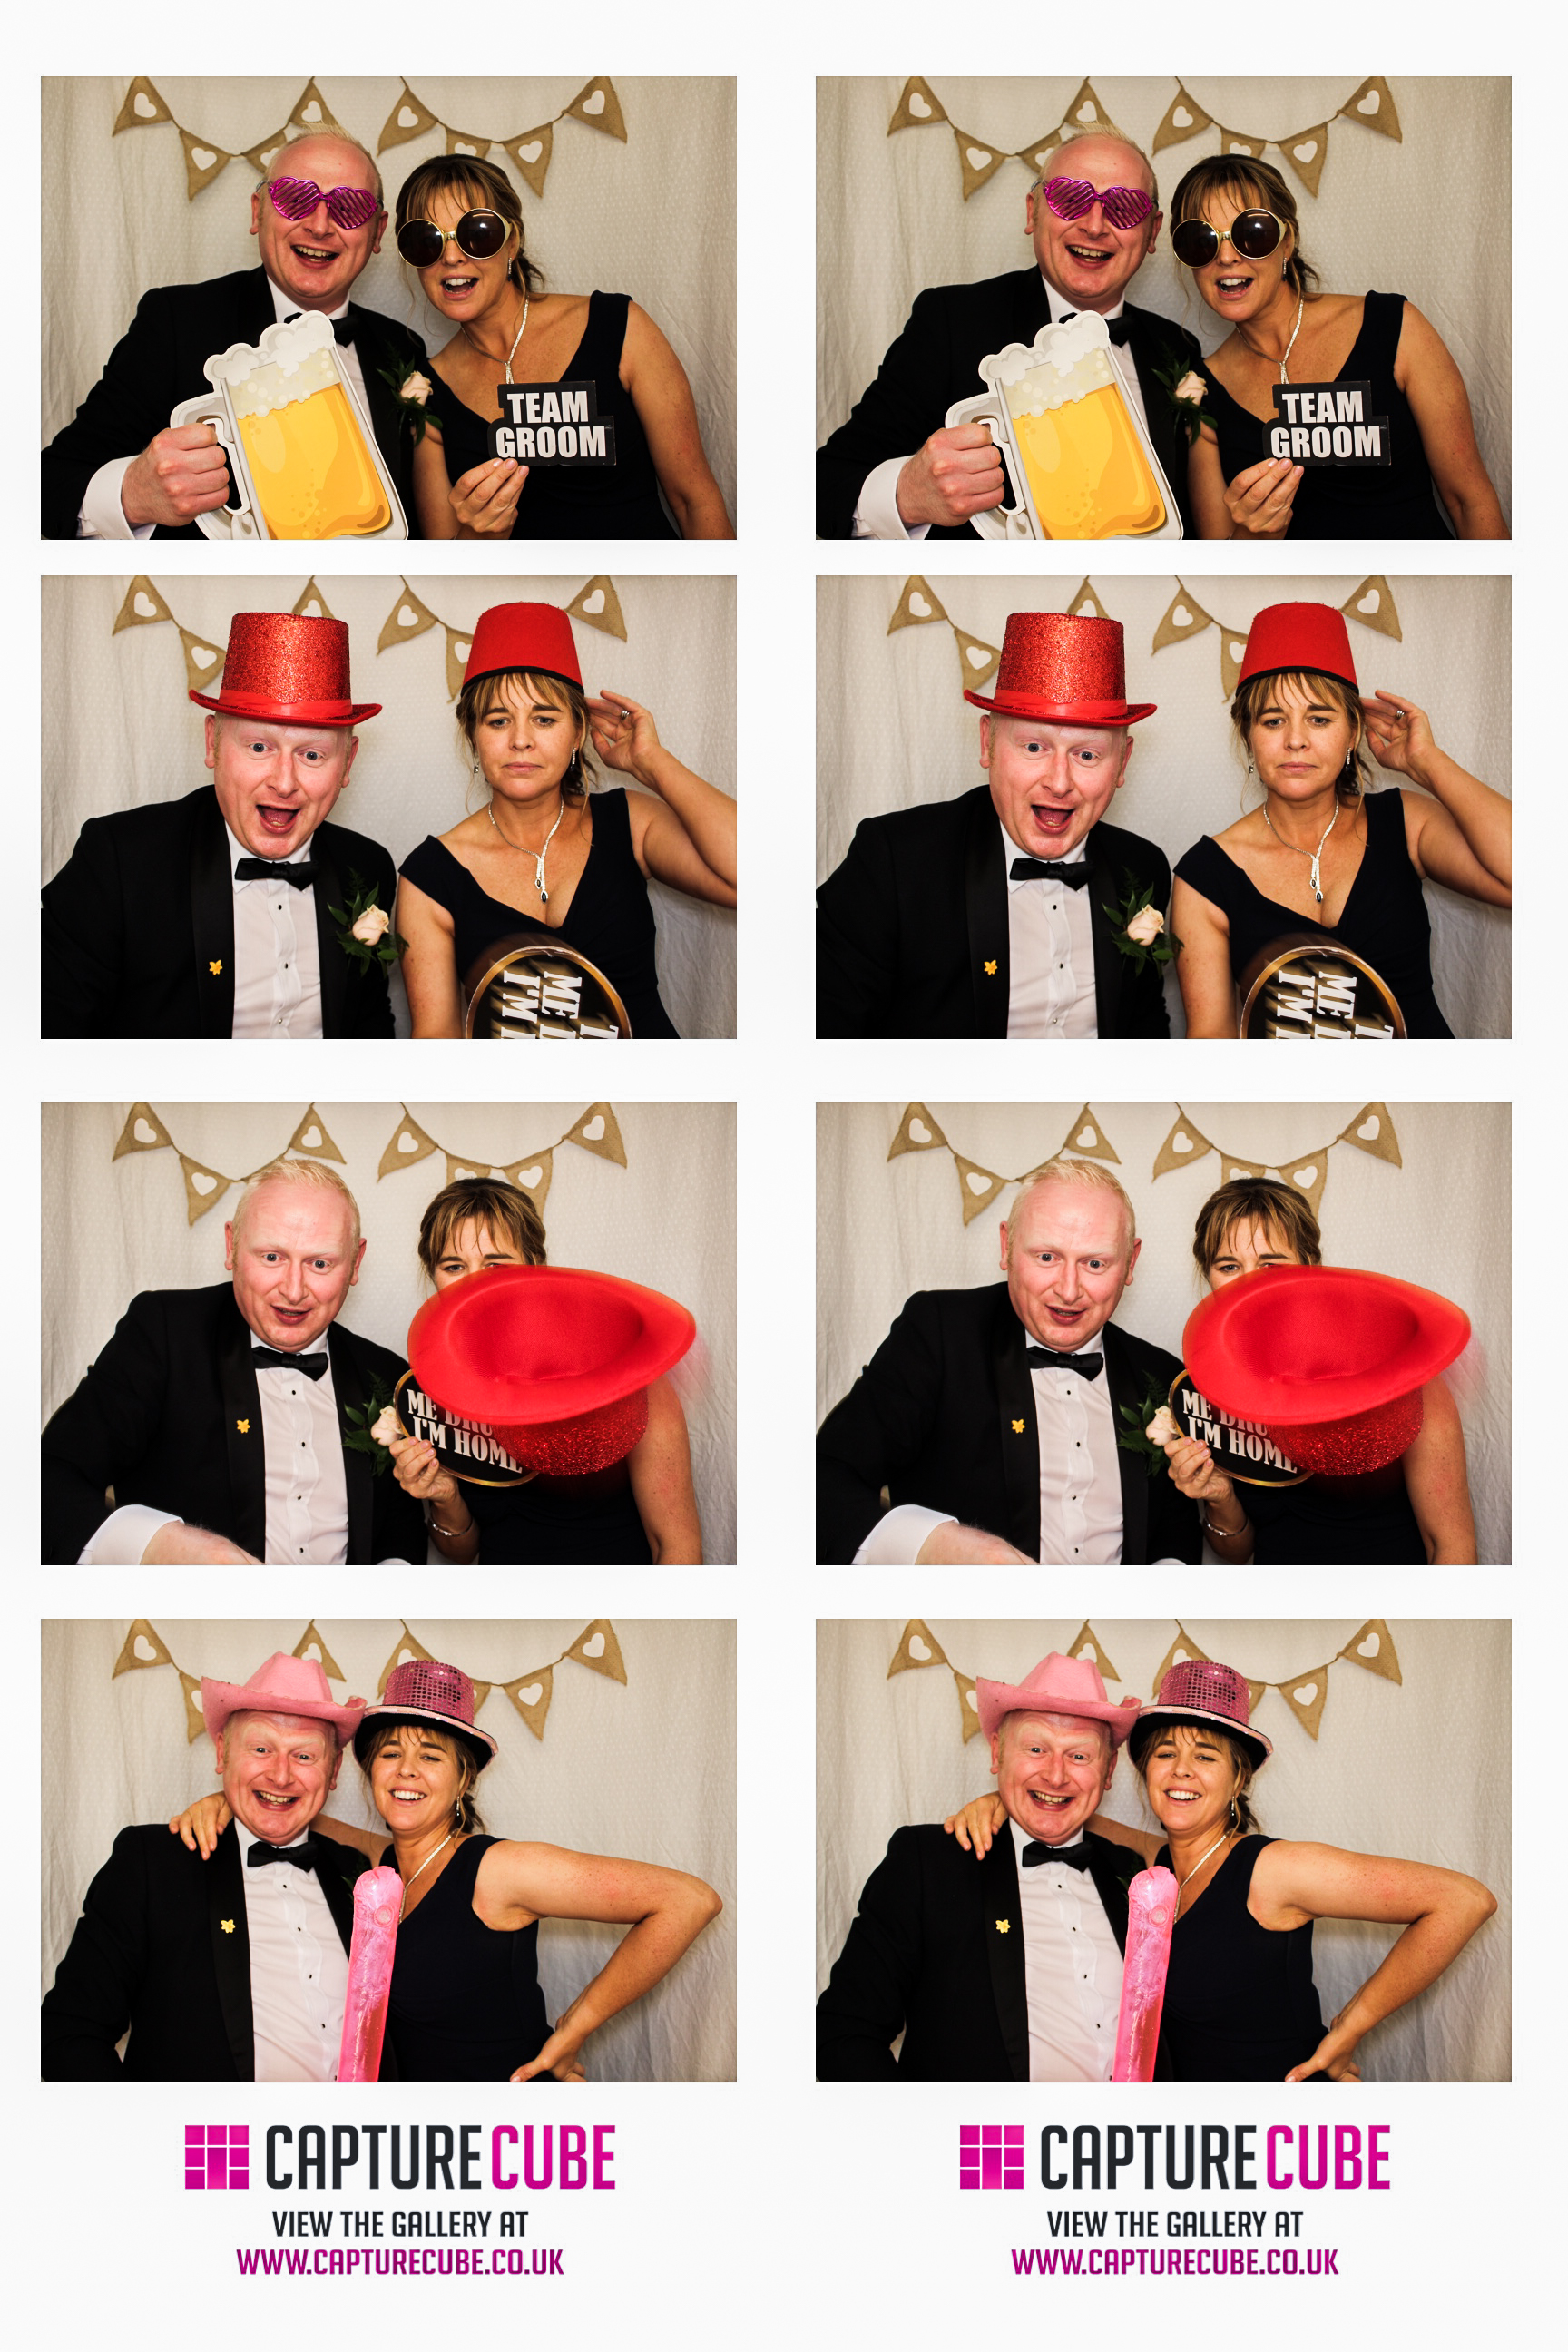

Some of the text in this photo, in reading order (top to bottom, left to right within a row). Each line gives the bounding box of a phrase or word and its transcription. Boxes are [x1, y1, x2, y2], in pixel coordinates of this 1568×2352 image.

[506, 390, 589, 424] TEAM
[1281, 390, 1364, 424] TEAM
[495, 426, 606, 458] GROOM
[1270, 426, 1381, 458] GROOM
[542, 970, 583, 1019] ME
[1317, 970, 1357, 1019] ME
[407, 1388, 437, 1421] ME
[1181, 1388, 1212, 1421] ME
[413, 1416, 447, 1450] I'M
[1188, 1416, 1222, 1450] I'M
